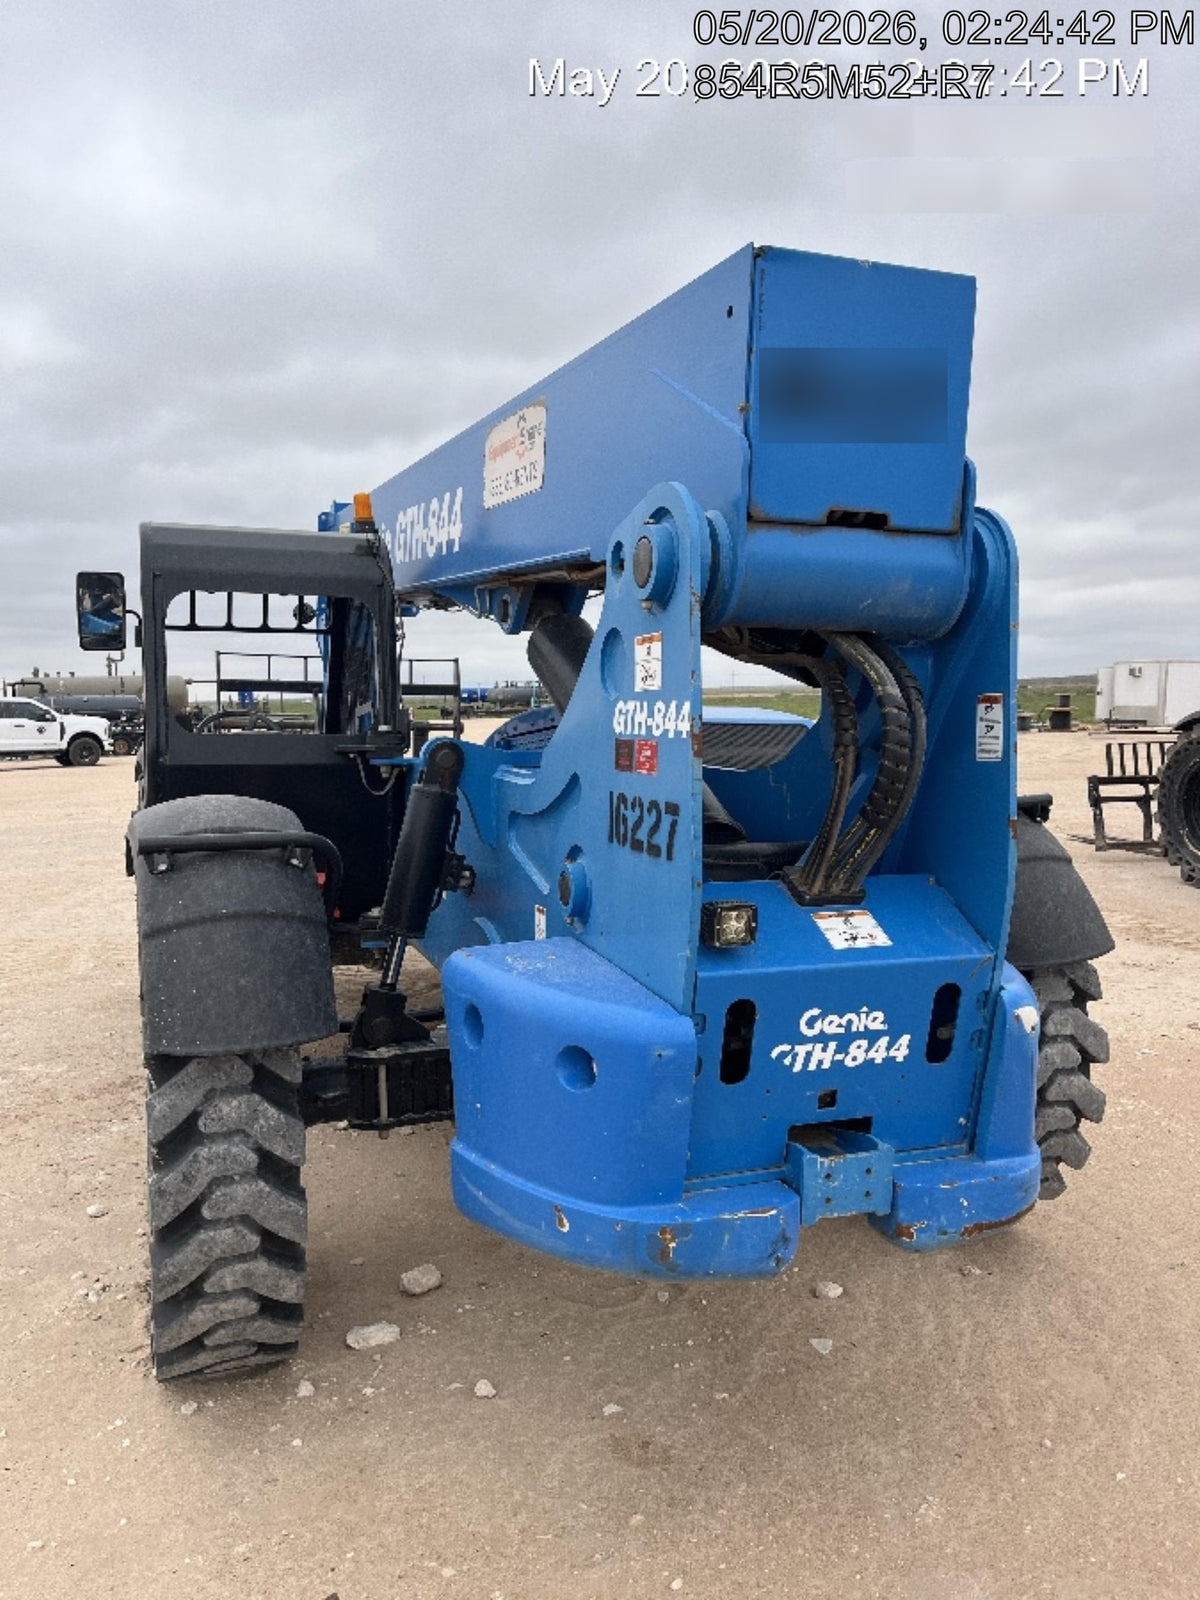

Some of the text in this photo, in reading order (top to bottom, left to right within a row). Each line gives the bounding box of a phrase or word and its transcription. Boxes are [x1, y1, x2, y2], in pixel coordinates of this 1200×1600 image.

[395, 486, 463, 565] GTH-844
[613, 700, 691, 739] GTH-844
[607, 790, 681, 862] 16227
[799, 1005, 888, 1037] Genie
